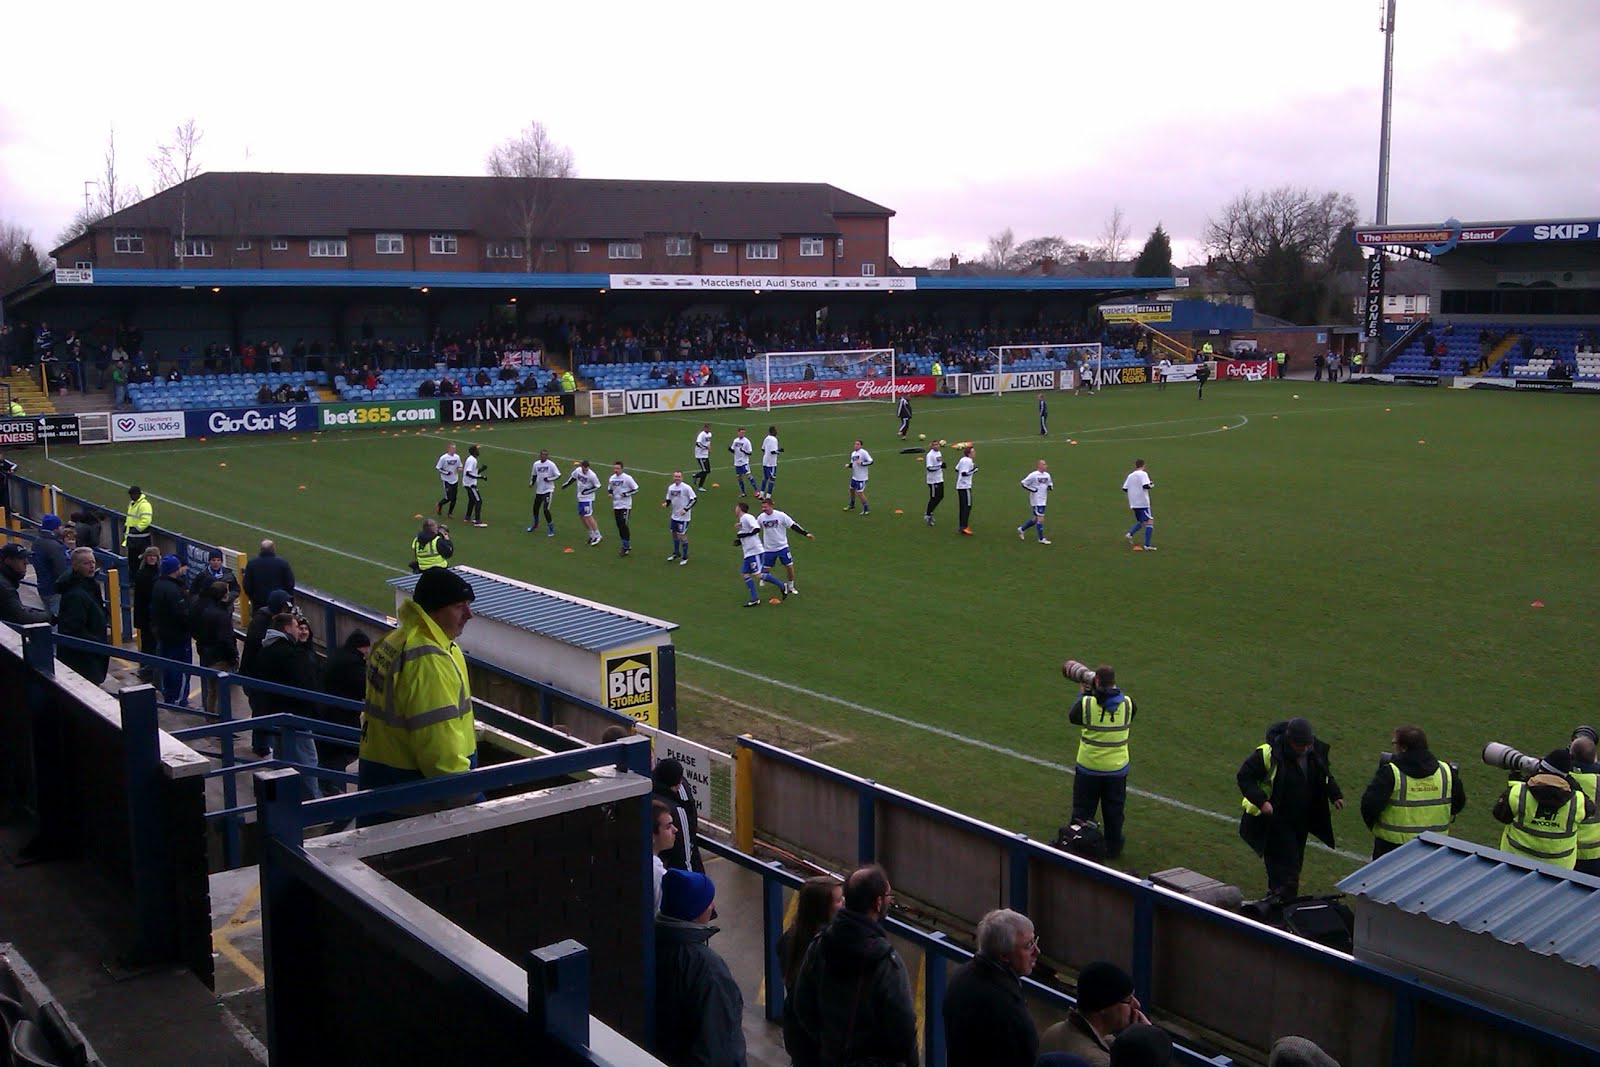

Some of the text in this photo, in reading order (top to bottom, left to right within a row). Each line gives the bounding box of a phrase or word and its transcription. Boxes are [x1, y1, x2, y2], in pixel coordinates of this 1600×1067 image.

[1363, 231, 1495, 242] The HENSHAWS Stand
[1533, 224, 1589, 240] SKIP
[1370, 254, 1381, 288] JACK
[701, 278, 817, 288] Macclesfield Audi Stand
[1089, 369, 1122, 386] ANK
[1122, 368, 1145, 376] FUTURE
[1122, 374, 1147, 383] FASHION
[856, 380, 926, 397] Budweiser
[974, 376, 995, 390] VOI
[1011, 373, 1053, 389] JEANS
[520, 396, 561, 407] FUTURE
[629, 388, 740, 410] VOI JEANS
[744, 387, 818, 404] Budweiser
[323, 406, 437, 425] bet365.com
[452, 397, 519, 422] BANK
[520, 405, 564, 418] FASHION
[610, 692, 651, 709] STORAGE
[667, 748, 696, 767] PLEASE
[686, 769, 709, 786] WALK
